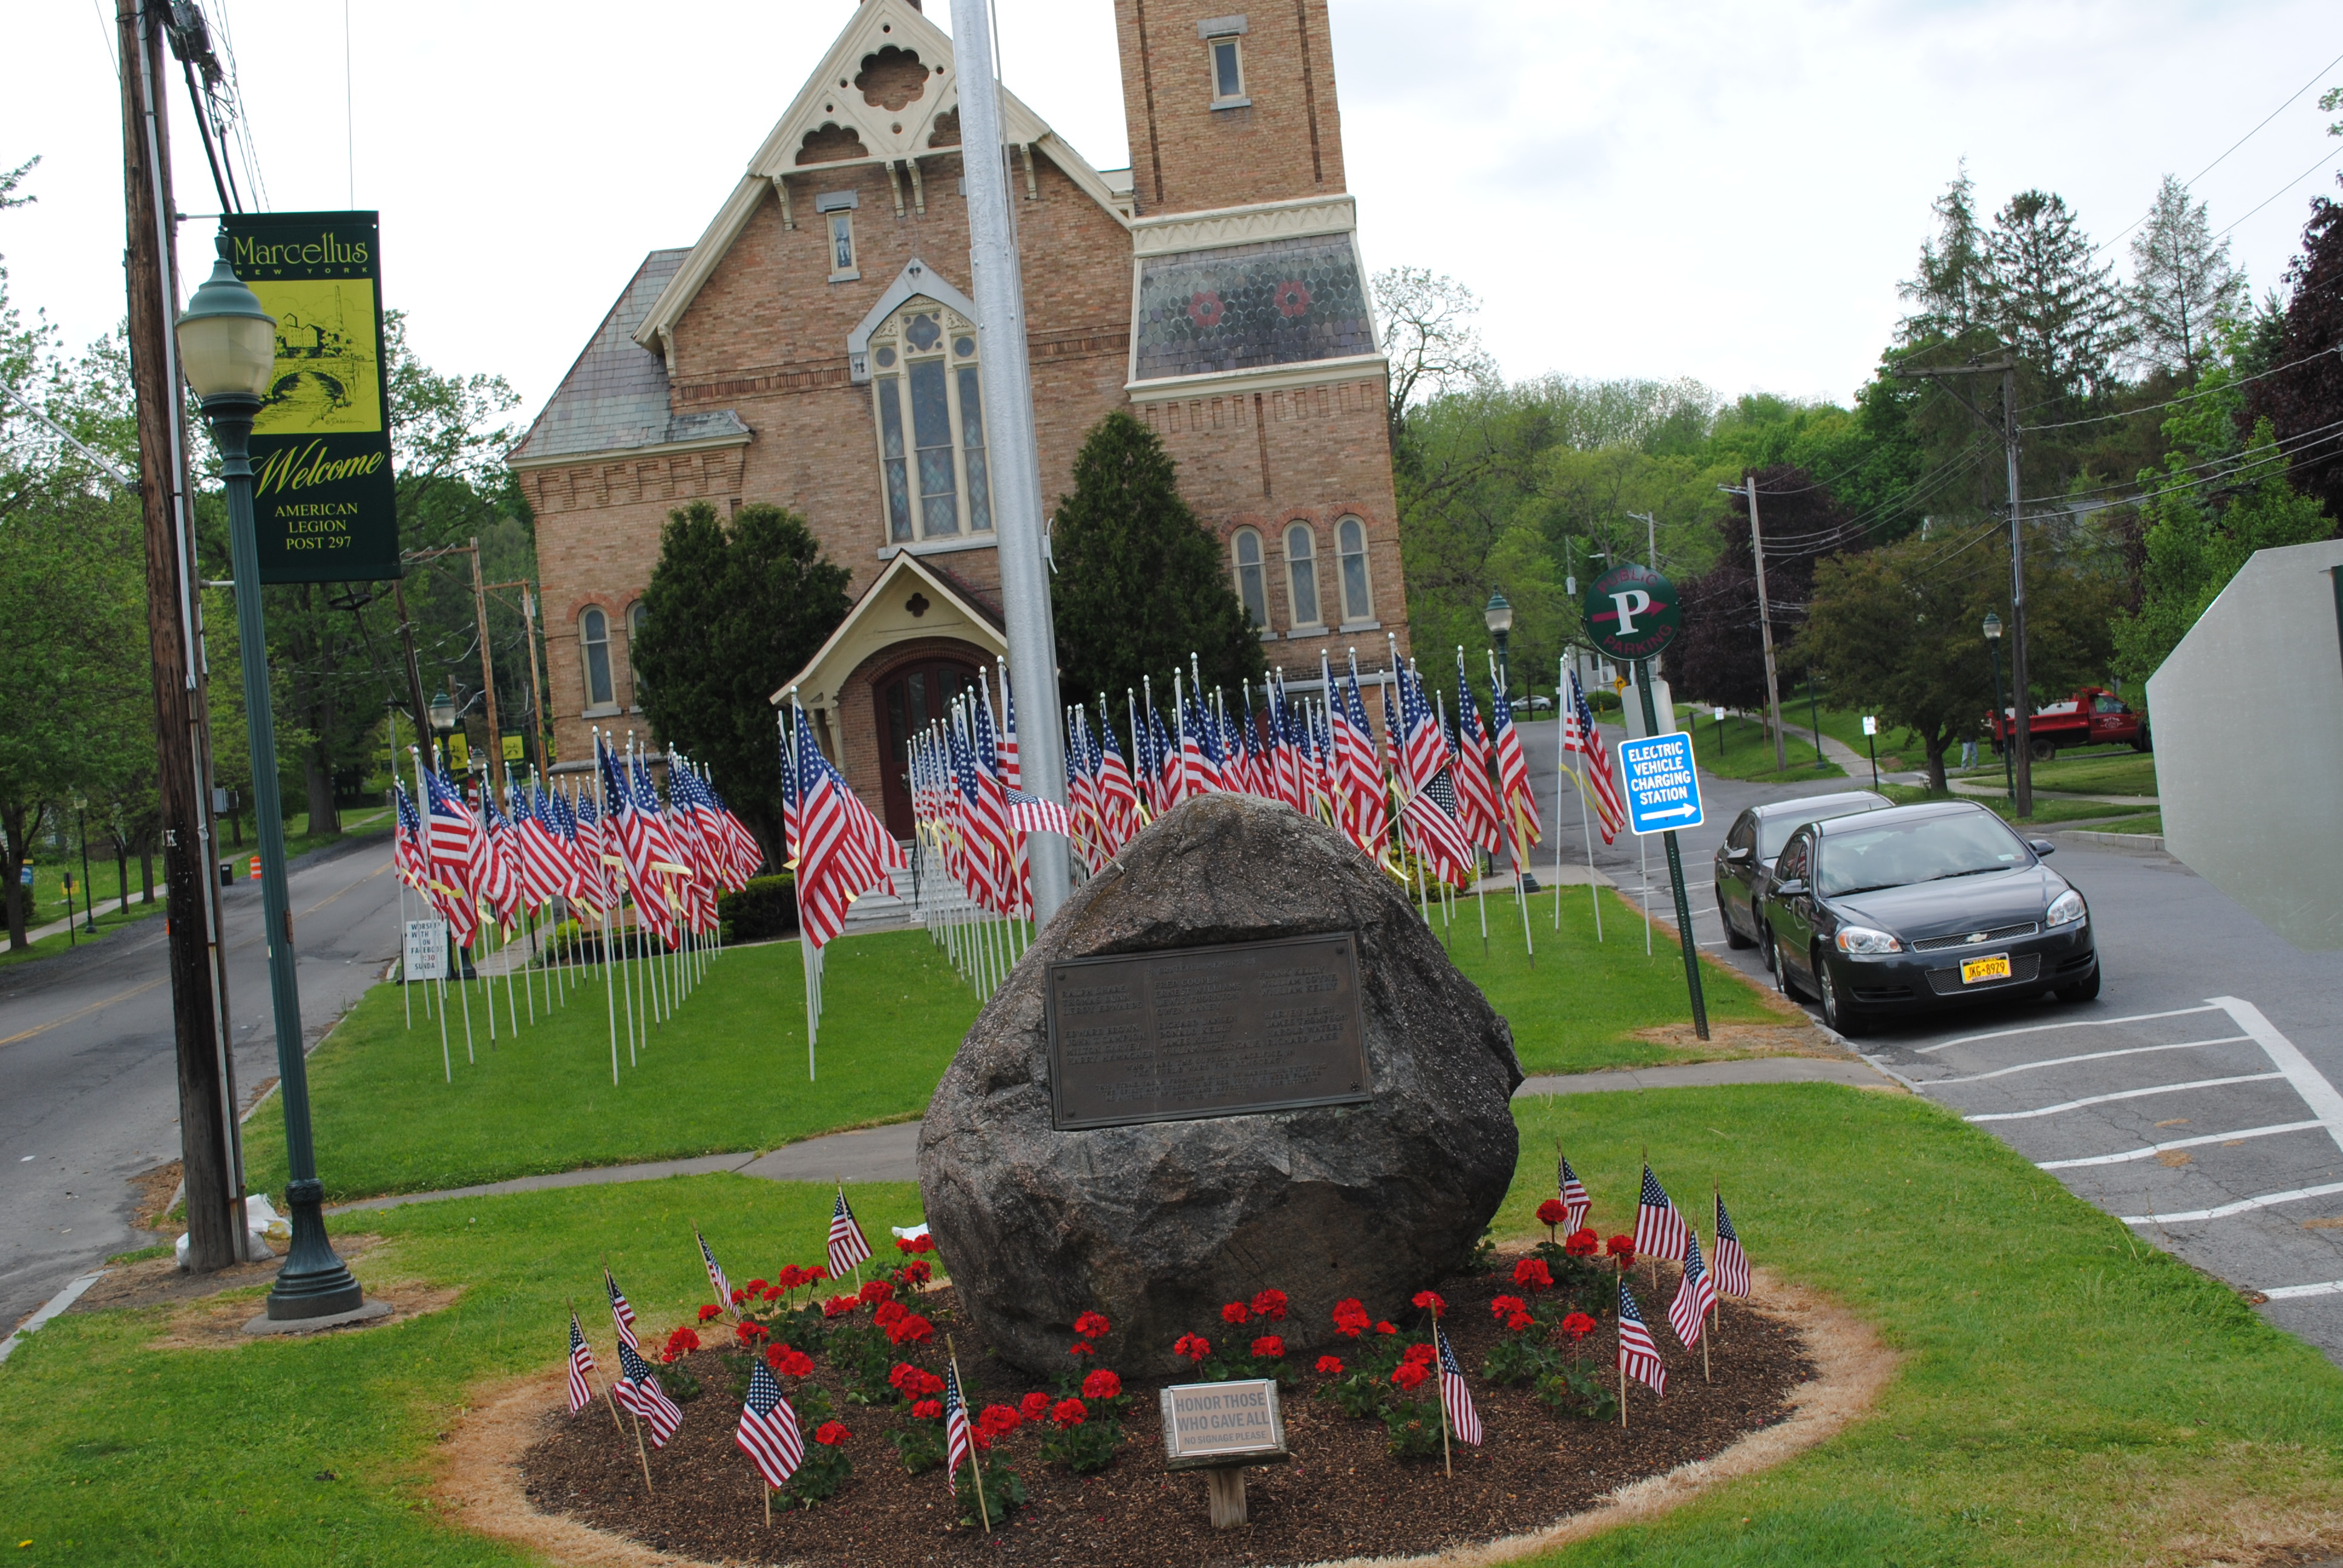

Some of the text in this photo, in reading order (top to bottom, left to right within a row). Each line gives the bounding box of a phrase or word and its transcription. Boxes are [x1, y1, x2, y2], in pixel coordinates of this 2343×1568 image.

[234, 232, 368, 264] Marcellus
[248, 438, 385, 498] Welcome
[275, 503, 358, 517] AMERICAN
[289, 520, 347, 533] LEGION
[286, 536, 351, 550] POST 297
[1598, 569, 1657, 594] PUBLIC
[1609, 590, 1650, 636] P
[1603, 624, 1672, 654] PARKING
[1628, 742, 1683, 762] ELECTRIC
[1633, 757, 1684, 776] VEHICLE
[1631, 770, 1691, 792] CHARGING
[1639, 786, 1688, 805] STATION
[1259, 969, 1291, 979] FRANK
[1154, 976, 1219, 989] FRED COOPER
[1259, 977, 1301, 988] WILLIAM
[1155, 982, 1242, 998] ERNEST WILLIAMS
[1260, 985, 1302, 997] WILLIAM
[1062, 993, 1130, 1007] THOMAS DUNN
[1155, 991, 1240, 1007] LEWIS THORNTON
[1099, 1001, 1142, 1012] EDWARDS
[1156, 1006, 1184, 1016] OWEN
[1264, 1008, 1303, 1019] HARVEY
[1064, 1024, 1139, 1038] EDWARD BROWN
[1158, 1018, 1198, 1030] RICHARD
[1159, 1024, 1233, 1039] DONALD KELLY
[1065, 1037, 1090, 1047] JOHN
[1103, 1031, 1146, 1044] CAMPION
[1160, 1037, 1191, 1048] JAMES
[1268, 1035, 1308, 1046] RICHARD
[1066, 1042, 1142, 1056] MILTON GARVEY
[1161, 1045, 1198, 1056] WILLIAM
[1067, 1049, 1154, 1065] HARRY HAMACHER
[1176, 1393, 1265, 1412] HONOR THOSE
[1177, 1411, 1269, 1431] WHO GAVE ALL
[1185, 1431, 1266, 1445] NO SIGNAGE PLEASE
